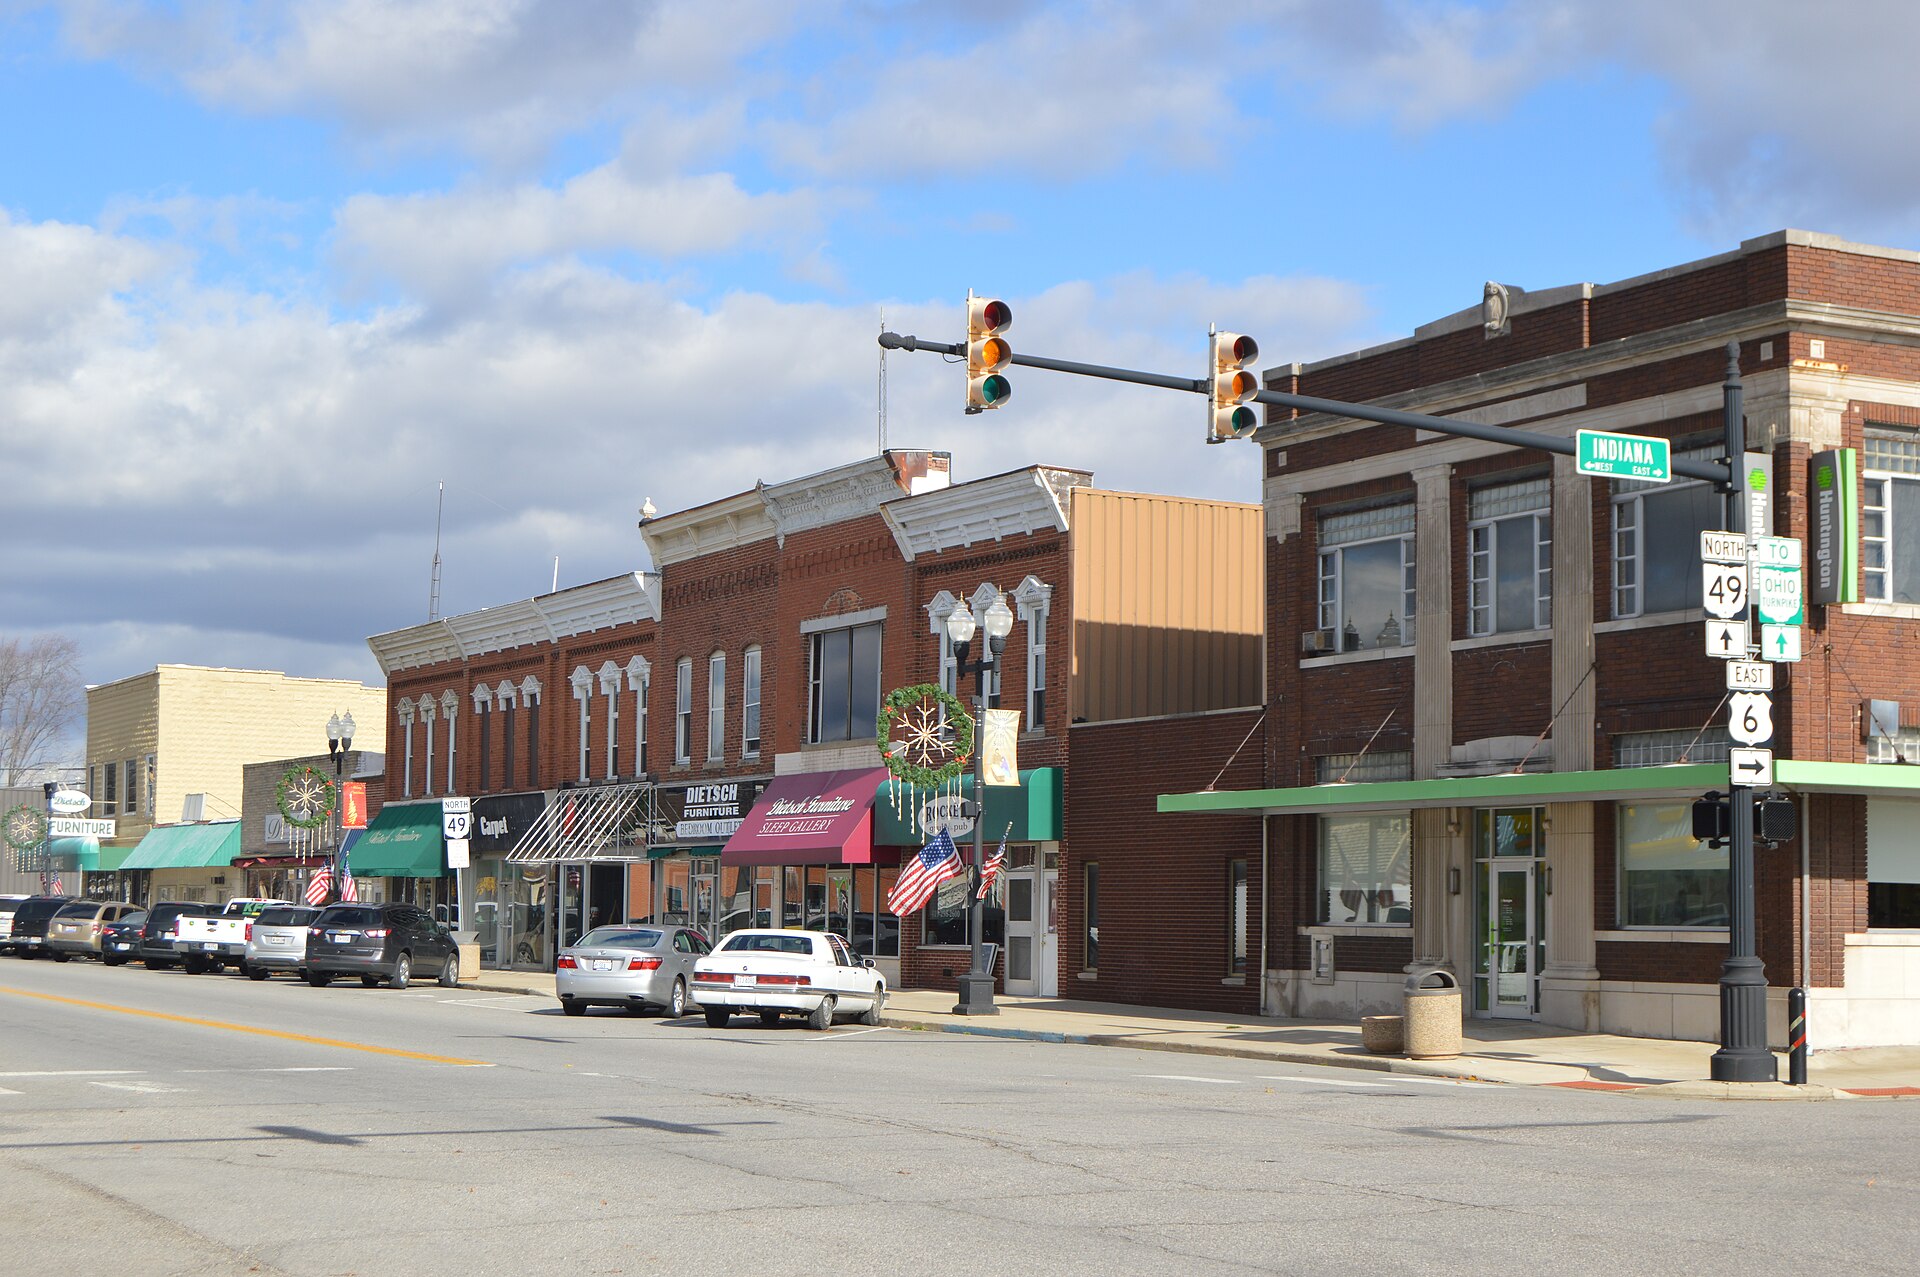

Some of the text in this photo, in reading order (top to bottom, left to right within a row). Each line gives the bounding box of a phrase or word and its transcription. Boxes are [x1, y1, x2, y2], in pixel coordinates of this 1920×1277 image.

[1593, 438, 1654, 465] INDIANA
[1594, 461, 1613, 472] WEST
[1632, 466, 1651, 476] EAST
[1705, 537, 1744, 557] NORTH
[1816, 490, 1833, 589] Huntington
[1769, 544, 1788, 559] TO
[1709, 575, 1741, 604] 49
[1765, 578, 1795, 593] OHIO
[1762, 597, 1798, 609] TURNPIKE
[1736, 666, 1764, 683] EAST
[1743, 704, 1758, 733] 6
[54, 796, 86, 806] Dietsch
[686, 784, 738, 803] DIETSCH
[445, 801, 469, 809] NORTH
[684, 806, 740, 818] FURNITURE
[766, 795, 855, 816] Dietsch Furniture
[49, 821, 112, 834] FURNITURE
[447, 817, 466, 832] 49
[480, 816, 509, 839] Carpet
[680, 821, 713, 835] BEDROOM
[759, 819, 835, 834] SLEEP GALLERY
[953, 822, 968, 832] pub
